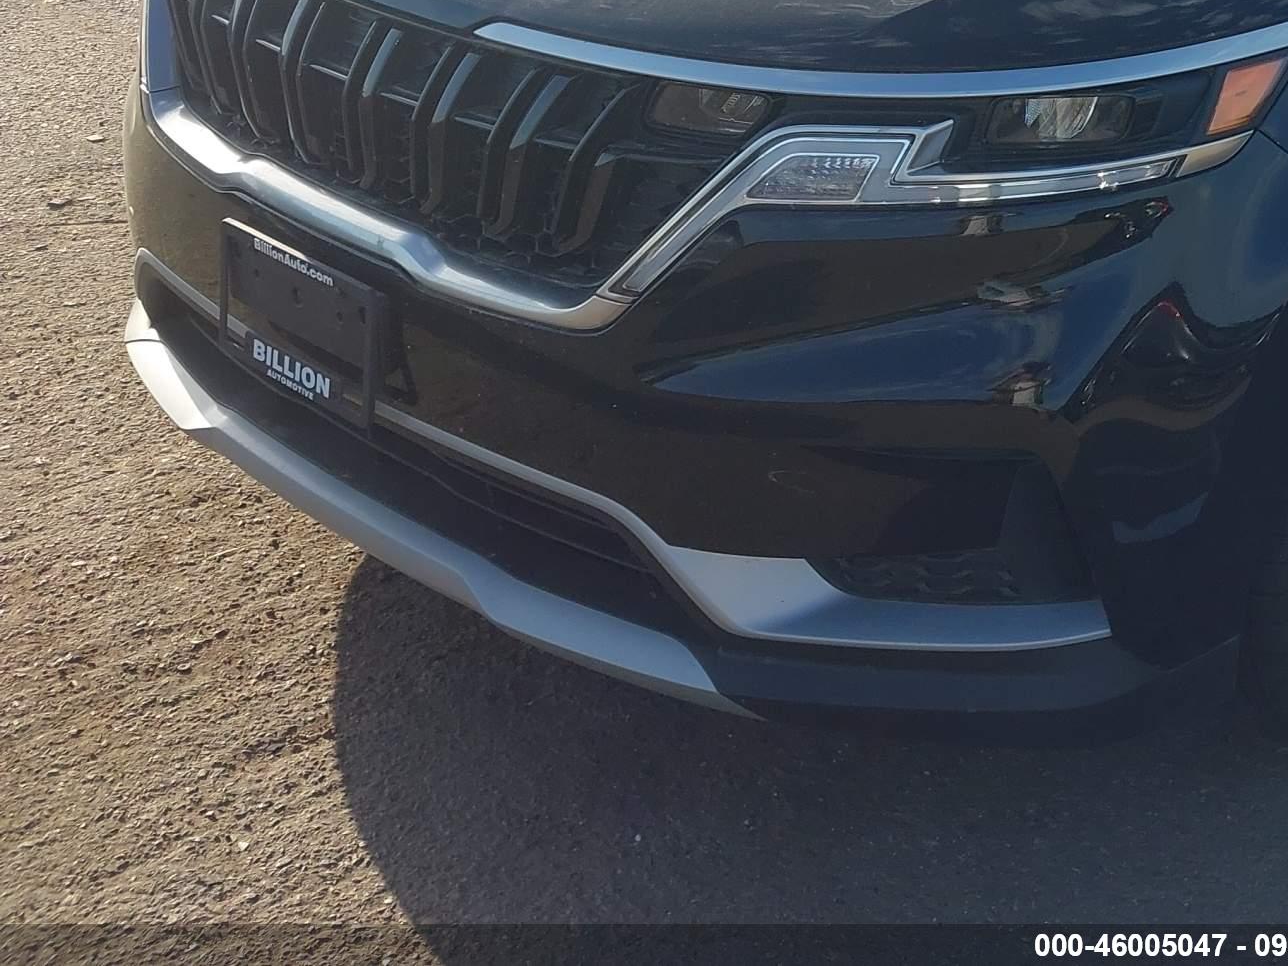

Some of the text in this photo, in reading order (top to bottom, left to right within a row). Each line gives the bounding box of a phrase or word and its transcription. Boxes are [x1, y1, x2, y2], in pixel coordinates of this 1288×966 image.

[253, 237, 334, 287] BillionAuto.com
[253, 338, 331, 399] BILLION
[266, 369, 314, 401] AUTOMOTIVE
